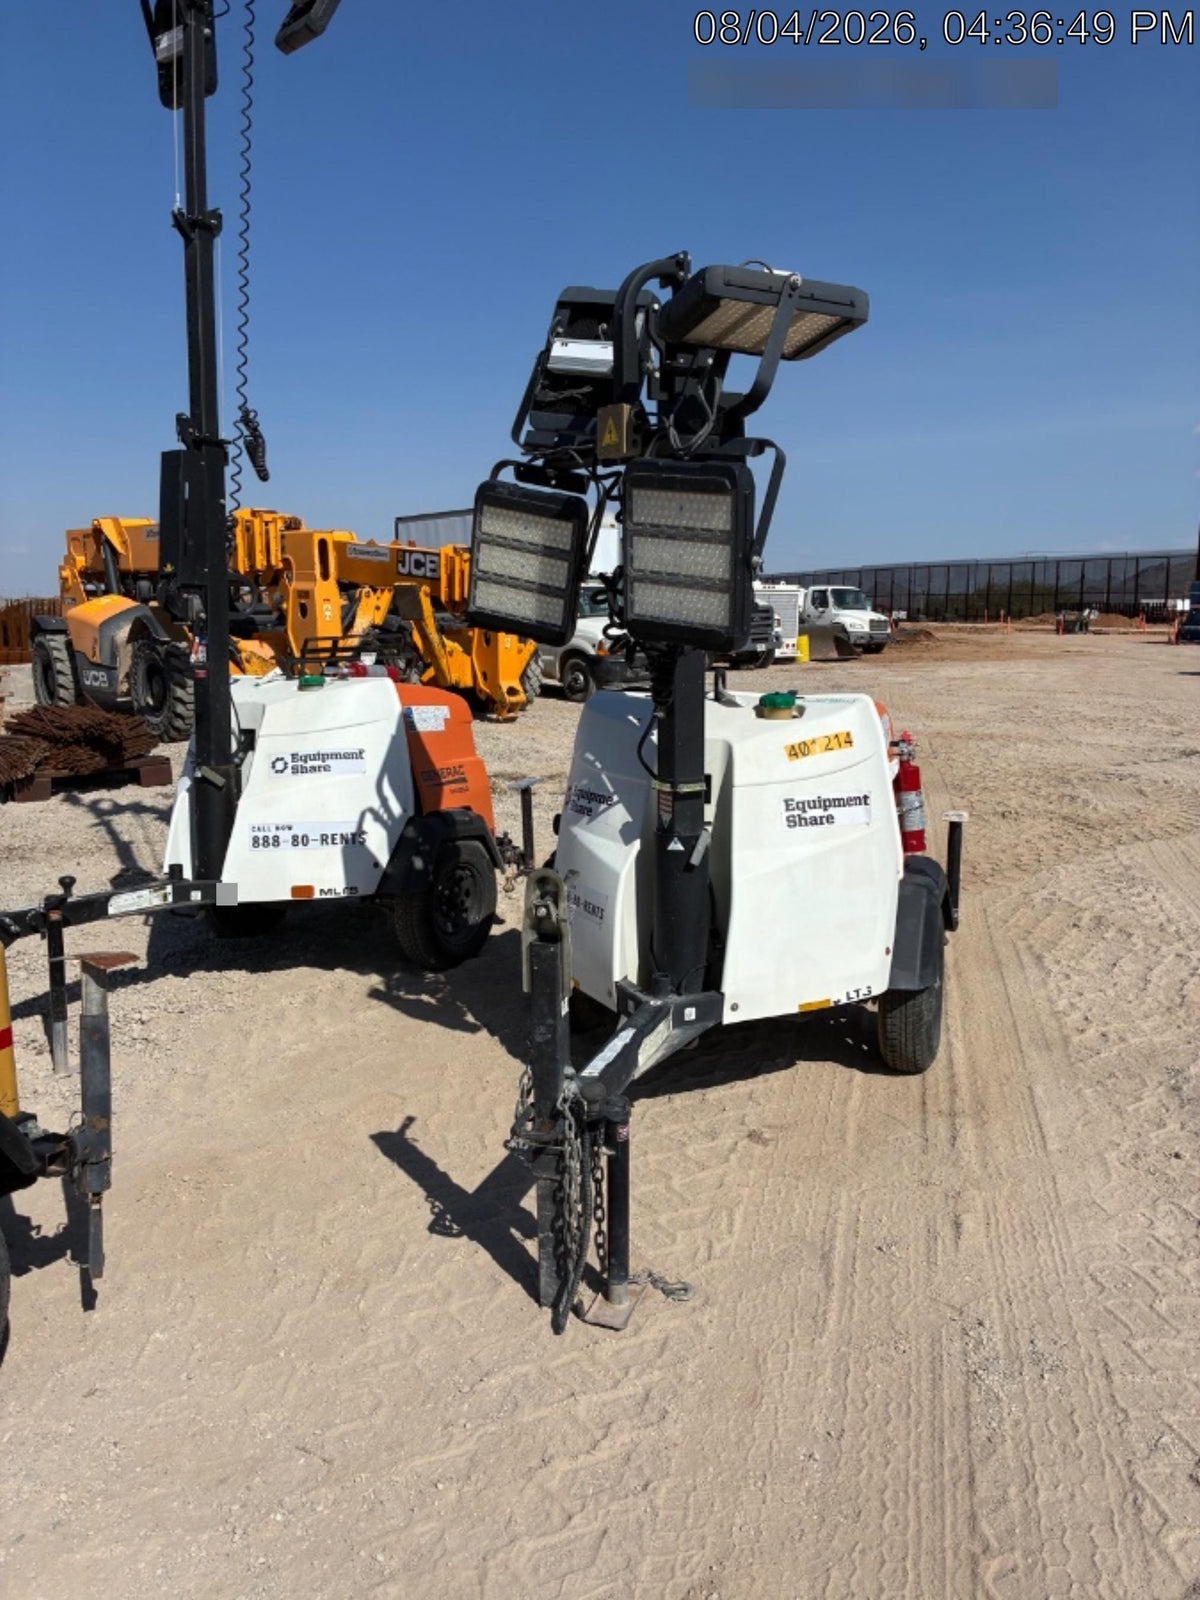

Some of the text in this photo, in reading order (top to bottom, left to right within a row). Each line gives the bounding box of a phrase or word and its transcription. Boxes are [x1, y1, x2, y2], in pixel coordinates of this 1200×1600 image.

[398, 551, 440, 579] JCB
[82, 669, 109, 687] JCB
[290, 748, 366, 764] Equipment
[290, 763, 332, 775] Share
[783, 794, 870, 813] Equipment
[251, 824, 273, 832] CALL
[785, 813, 835, 829] Share
[251, 830, 368, 848] 888-80-RENTS
